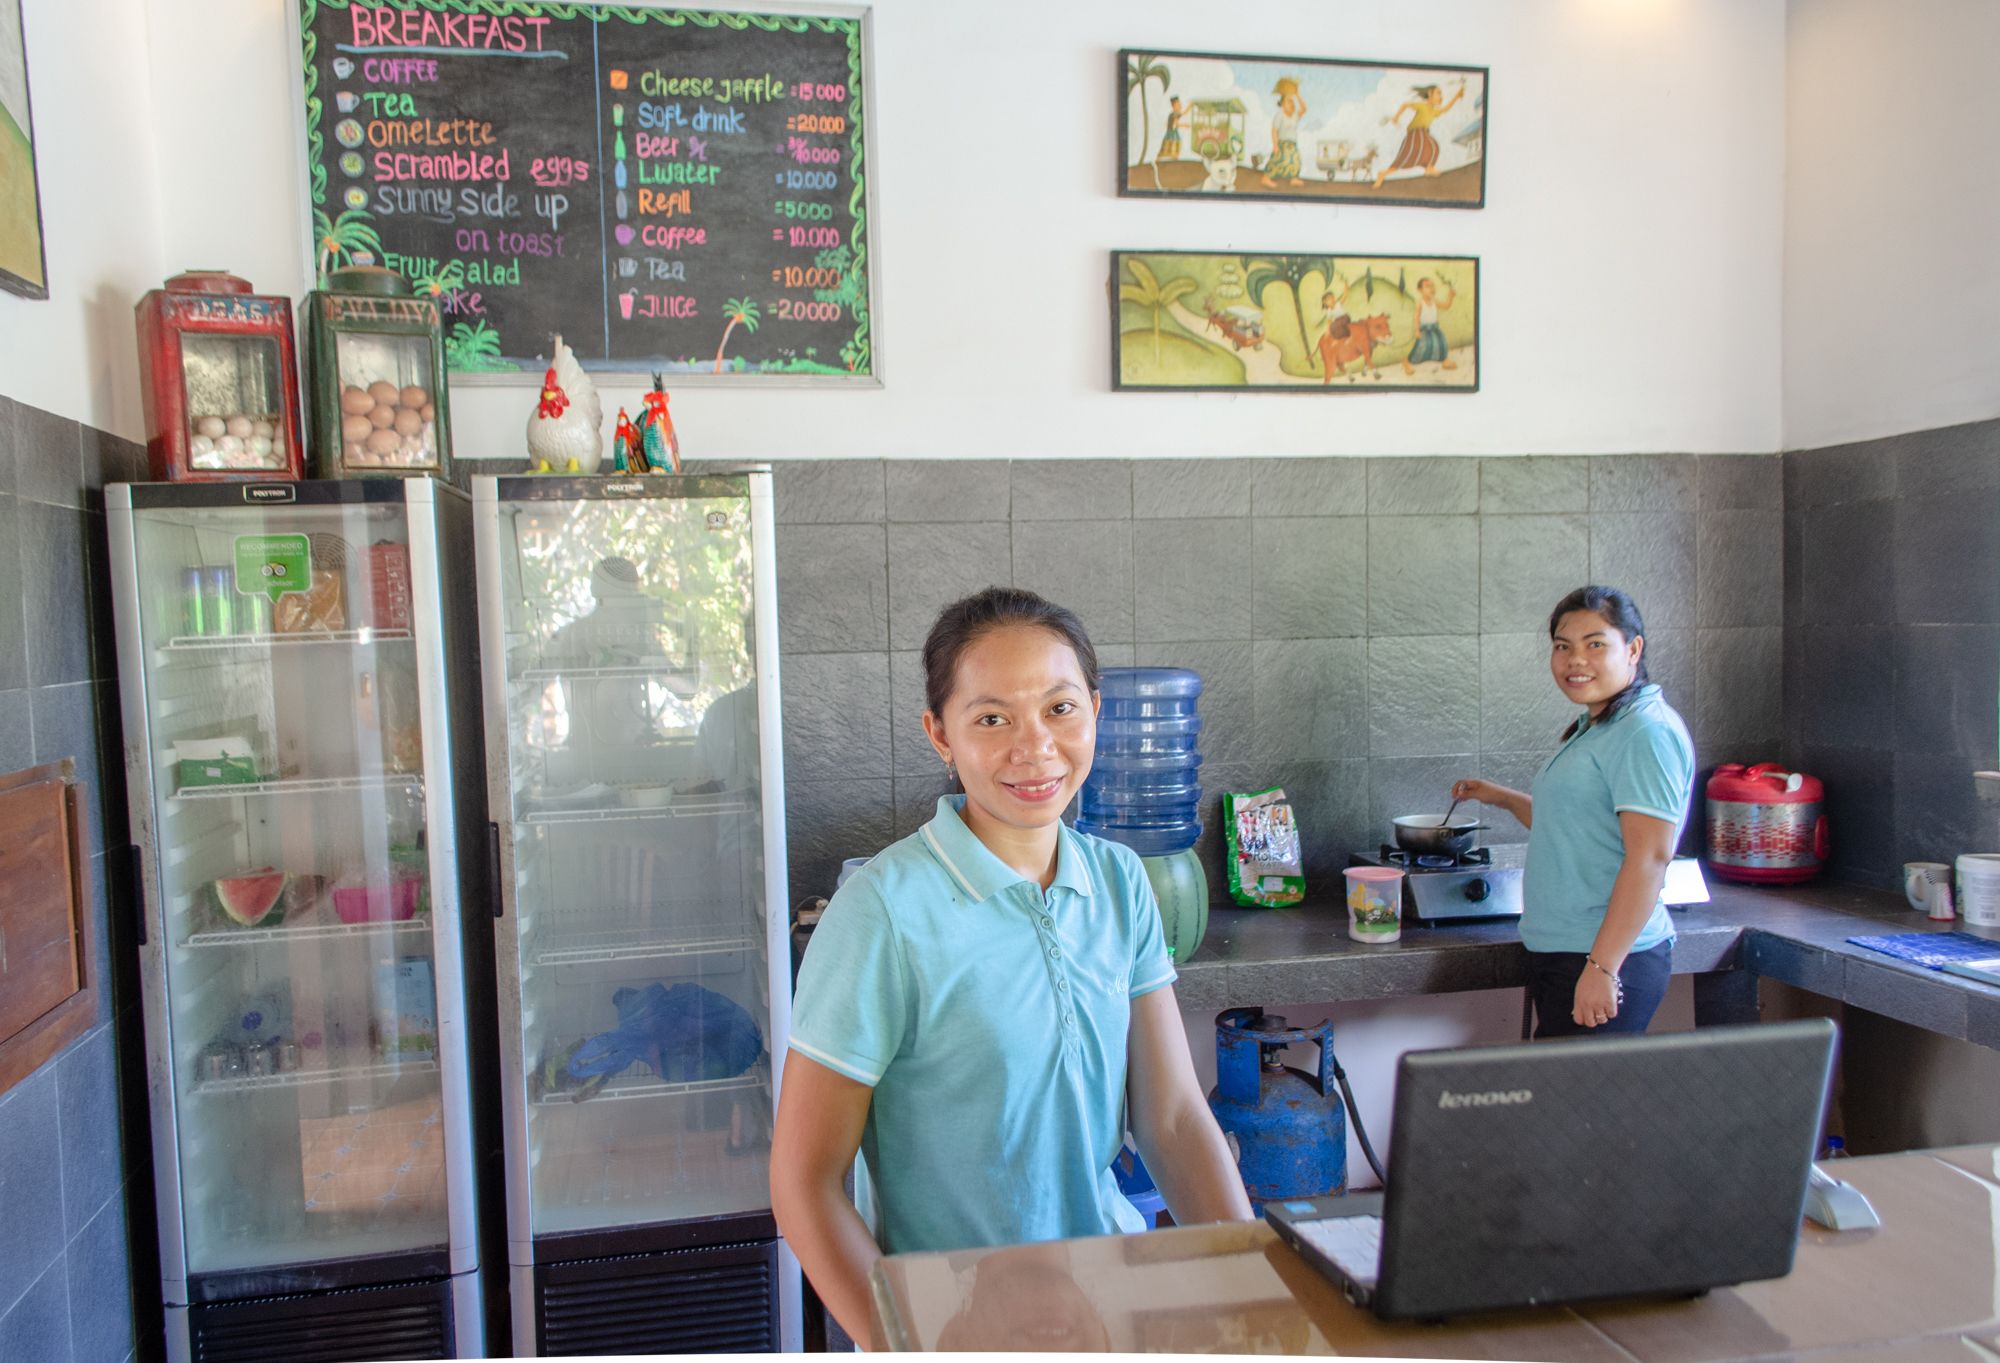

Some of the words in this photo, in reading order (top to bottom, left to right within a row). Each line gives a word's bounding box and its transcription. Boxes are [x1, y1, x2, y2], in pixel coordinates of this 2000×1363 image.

[350, 3, 551, 52] BREAKFAST
[363, 58, 439, 83] COFFEE
[640, 69, 714, 97] Cheese
[715, 73, 785, 104] jaffle
[363, 92, 418, 118] Tea
[638, 101, 688, 133] Soft
[691, 105, 746, 134] drink
[635, 132, 680, 160] Beer
[373, 147, 511, 182] Scrambled
[530, 155, 590, 187] eggs
[374, 185, 456, 224] Sunny
[457, 183, 520, 218] Side
[535, 193, 569, 232] up
[638, 188, 692, 218] Refill
[456, 229, 490, 252] on
[498, 229, 565, 257] toast
[642, 225, 707, 250] Coffee
[384, 253, 438, 279] Fruit
[450, 257, 520, 286] Salad
[643, 256, 686, 282] Tea
